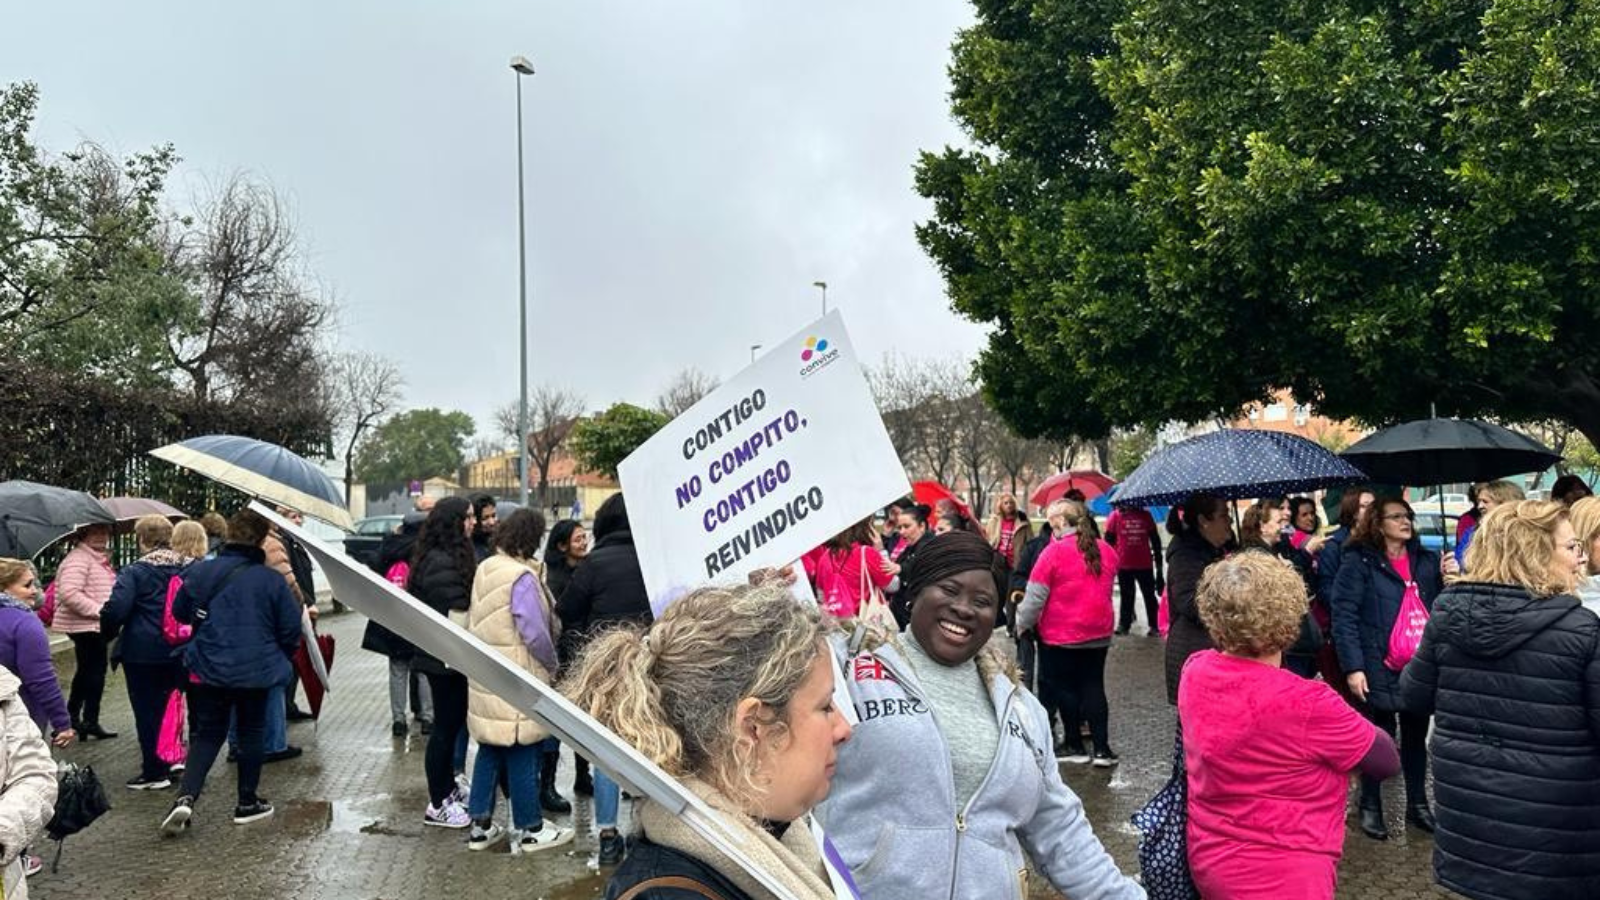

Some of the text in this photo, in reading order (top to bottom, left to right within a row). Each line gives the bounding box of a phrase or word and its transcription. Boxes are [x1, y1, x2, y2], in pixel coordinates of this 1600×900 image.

[800, 349, 838, 375] convive
[675, 409, 808, 509] NO COMPITO,
[683, 388, 767, 460] CONTIGO
[703, 460, 791, 532] CONTIGO
[705, 486, 823, 578] REIVINDICO
